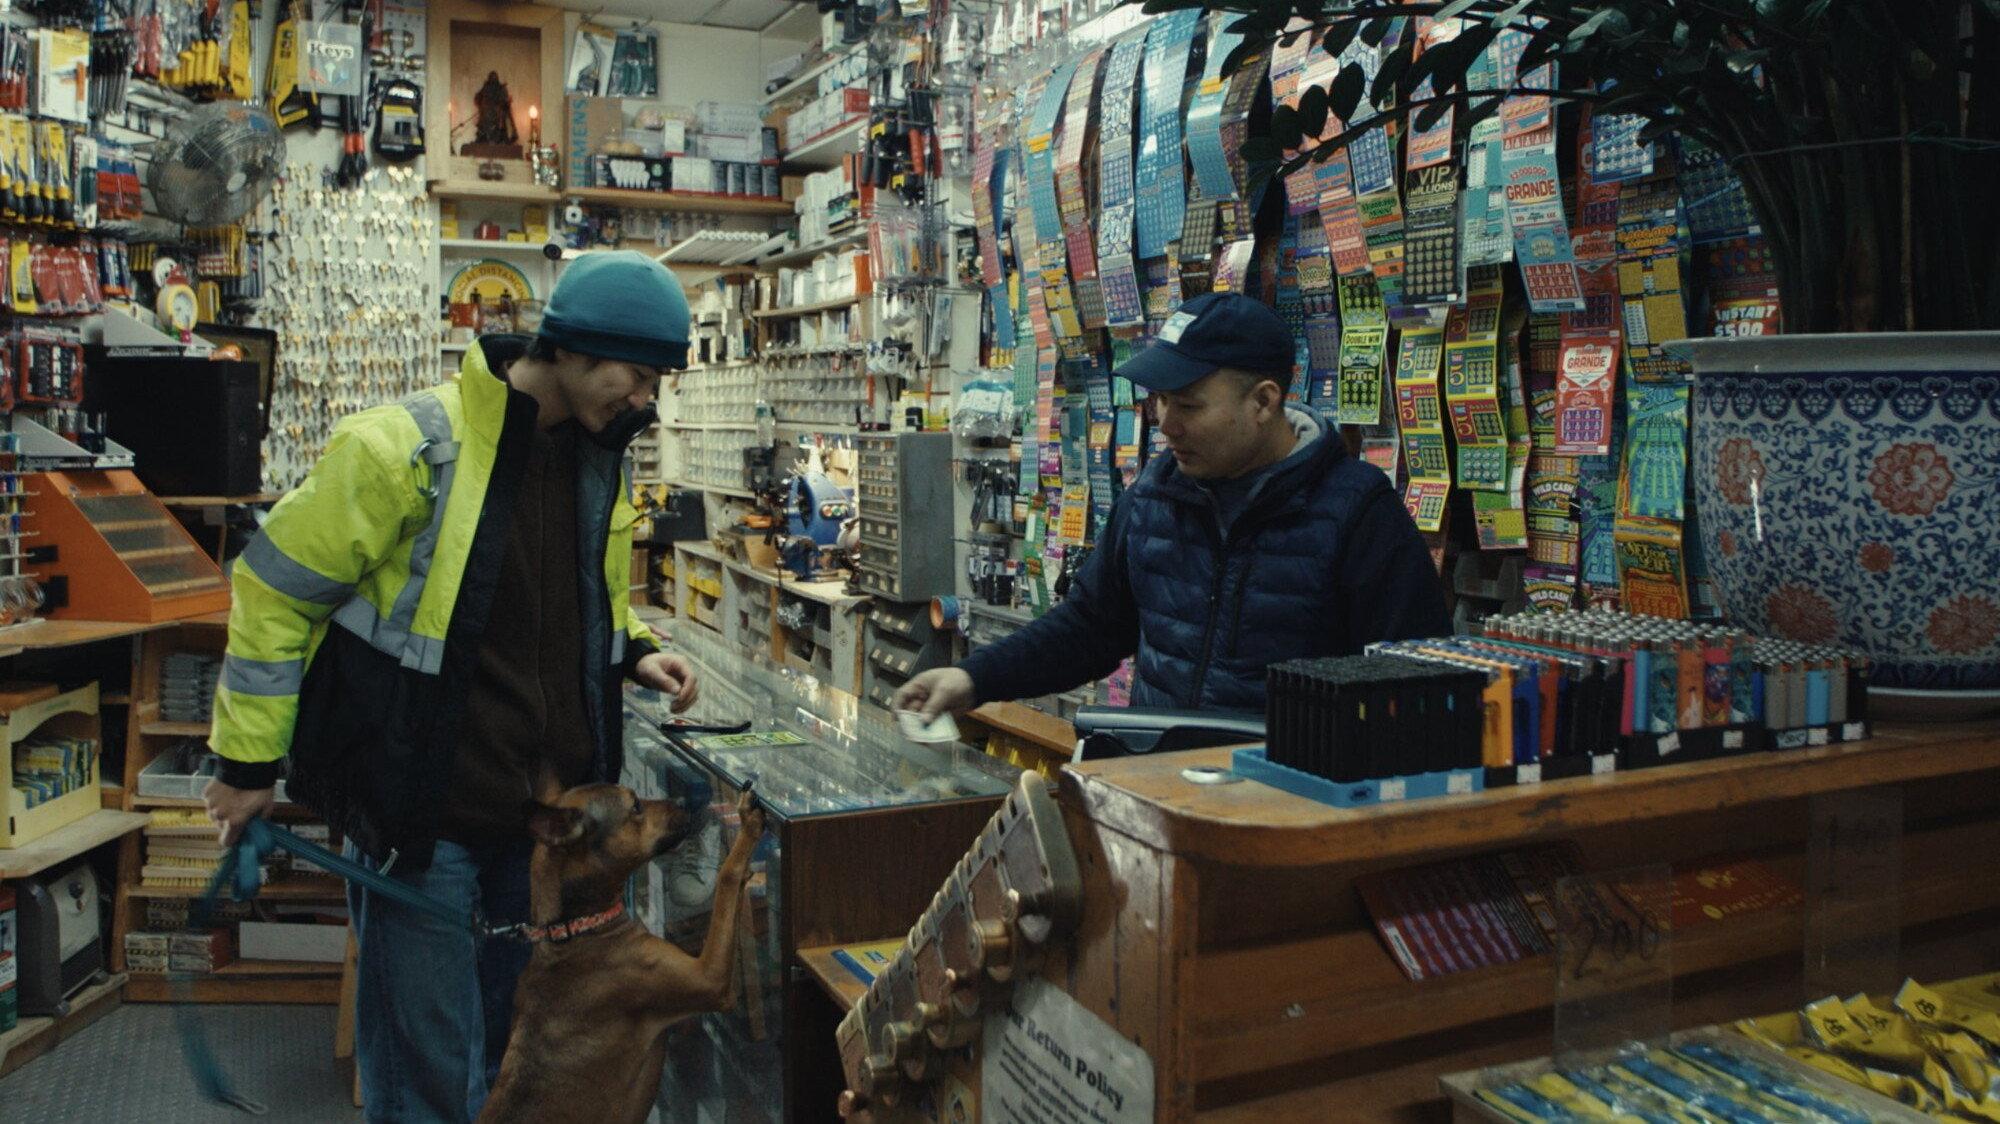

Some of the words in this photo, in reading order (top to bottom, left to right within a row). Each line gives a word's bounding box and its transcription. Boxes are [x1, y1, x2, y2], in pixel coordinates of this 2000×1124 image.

[310, 42, 354, 60] Keys
[573, 98, 588, 187] SIEMENS
[1418, 166, 1451, 185] VIP
[1410, 181, 1455, 197] MILLIONS
[1506, 179, 1557, 200] GRANDE
[1714, 305, 1777, 321] INSTANT
[1567, 355, 1607, 369] GRANDE
[1449, 364, 1465, 386] 5
[1533, 482, 1552, 496] WILD
[1553, 481, 1575, 494] CASH
[1529, 590, 1547, 602] WILD
[1548, 590, 1570, 602] CASH
[1027, 1018, 1072, 1071] Return
[1075, 1056, 1123, 1112] Policy
